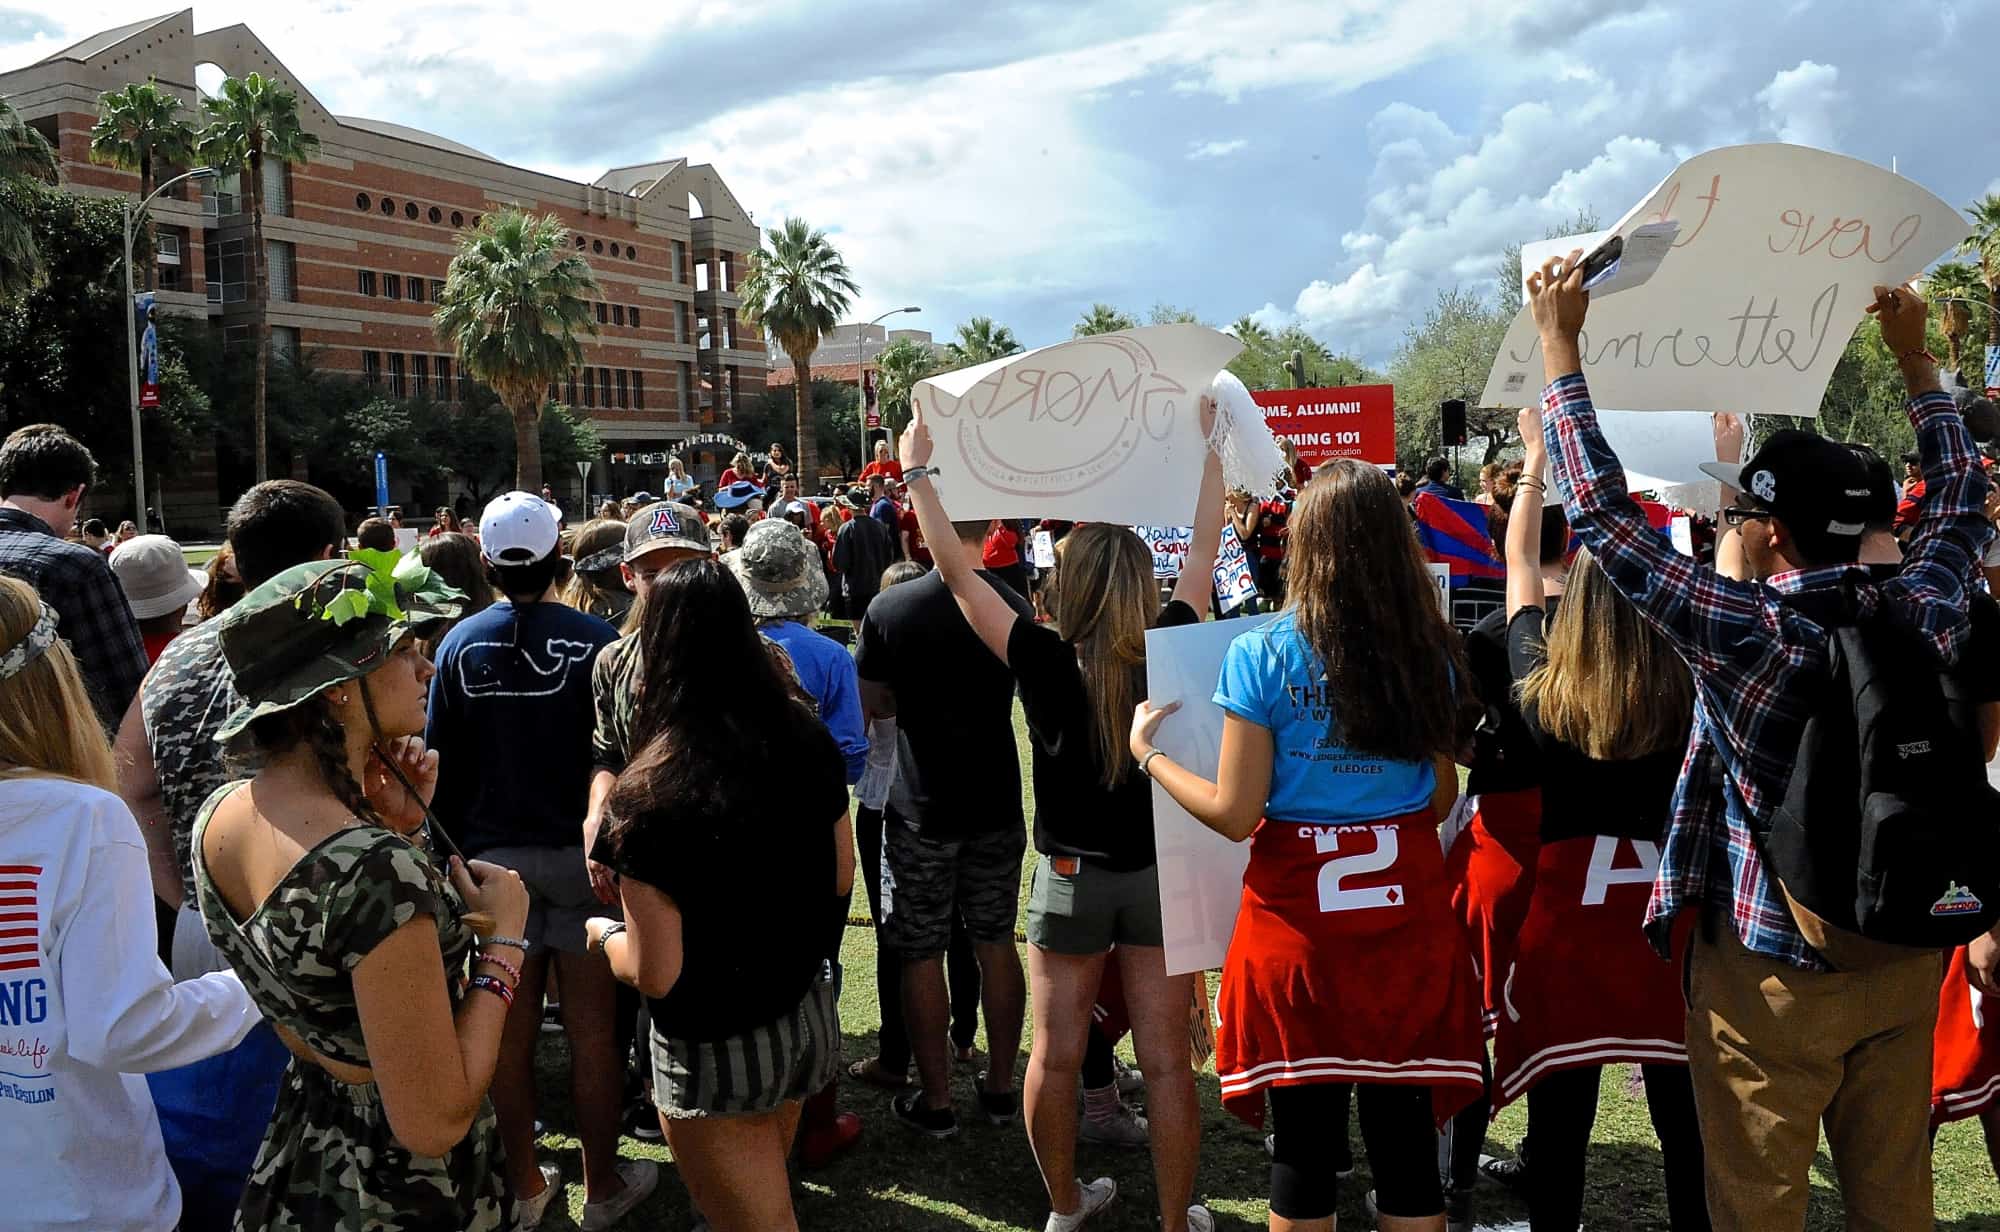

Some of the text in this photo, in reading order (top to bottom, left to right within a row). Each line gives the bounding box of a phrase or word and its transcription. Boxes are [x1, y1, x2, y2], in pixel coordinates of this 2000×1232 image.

[1296, 402, 1361, 417] ALUMNI!
[1335, 432, 1360, 444] 101
[1320, 448, 1361, 456] Association
[648, 507, 680, 536] A
[1222, 527, 1257, 594] RESPECT
[17, 1036, 50, 1069] life
